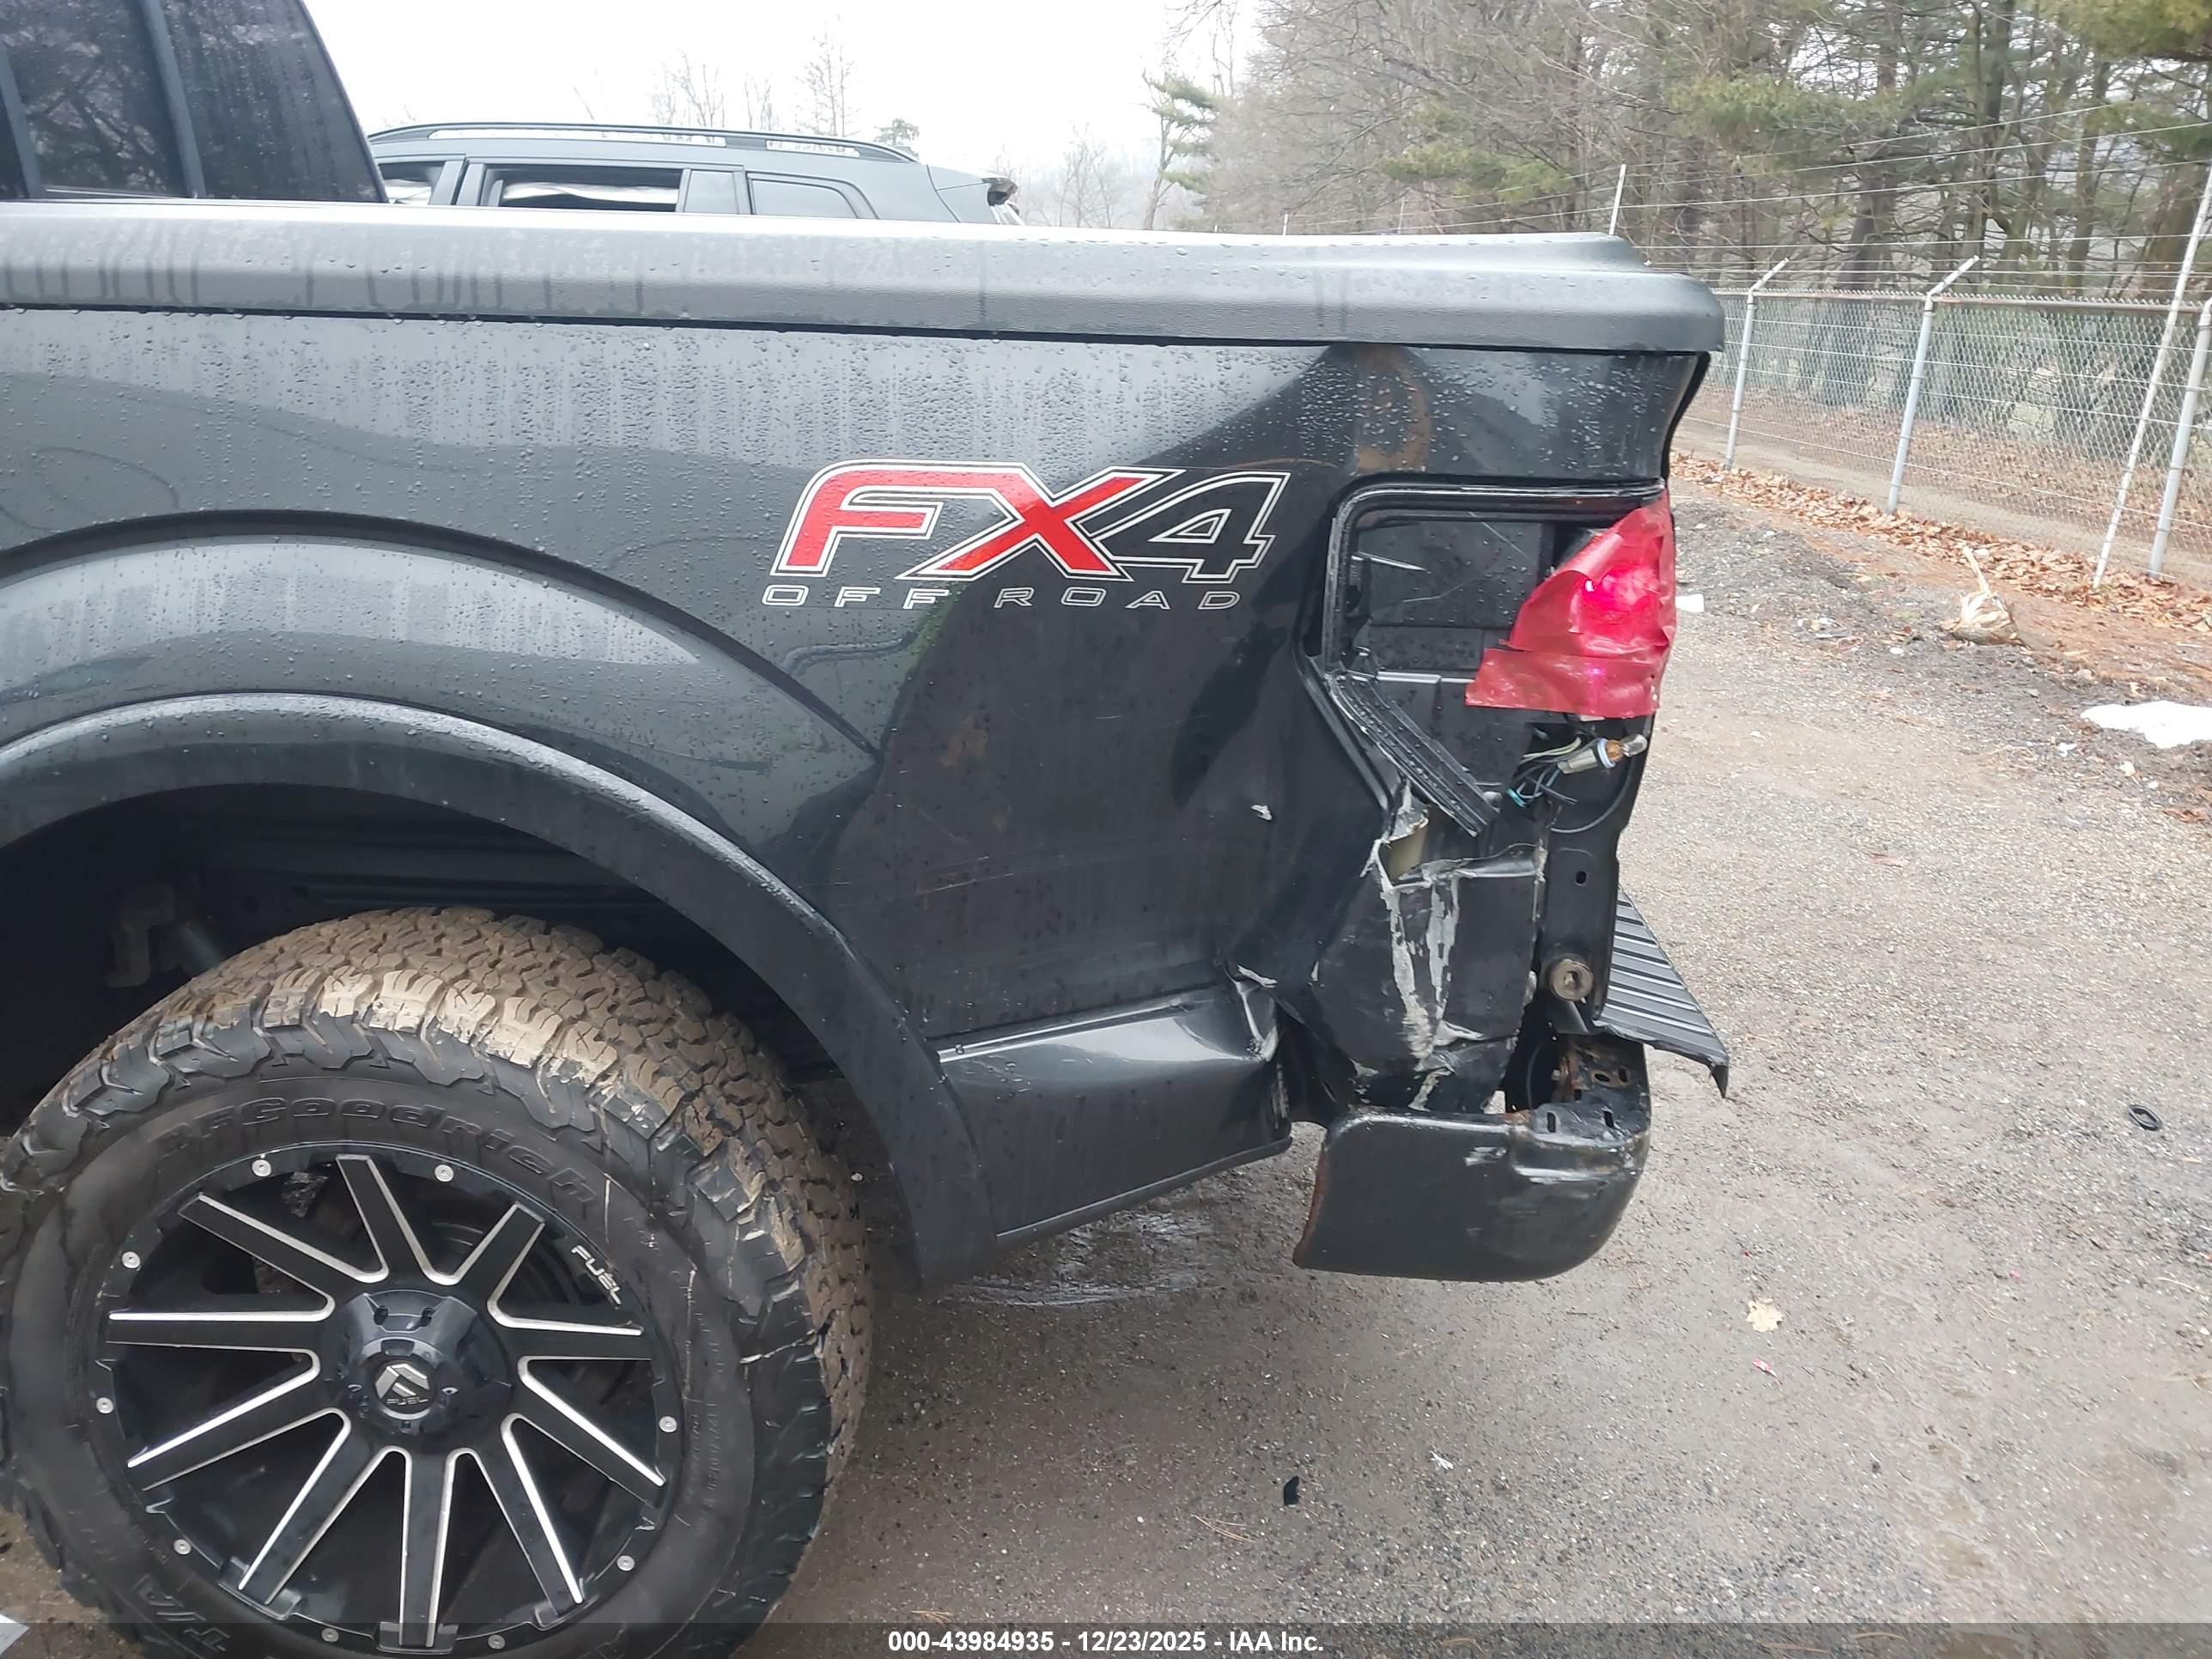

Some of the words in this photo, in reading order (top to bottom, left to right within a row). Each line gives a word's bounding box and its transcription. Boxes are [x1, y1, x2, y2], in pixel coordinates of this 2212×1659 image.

[769, 459, 1291, 584] FX4
[761, 584, 950, 610] OFF
[993, 586, 1242, 611] ROAD
[570, 1244, 622, 1305] FUEL
